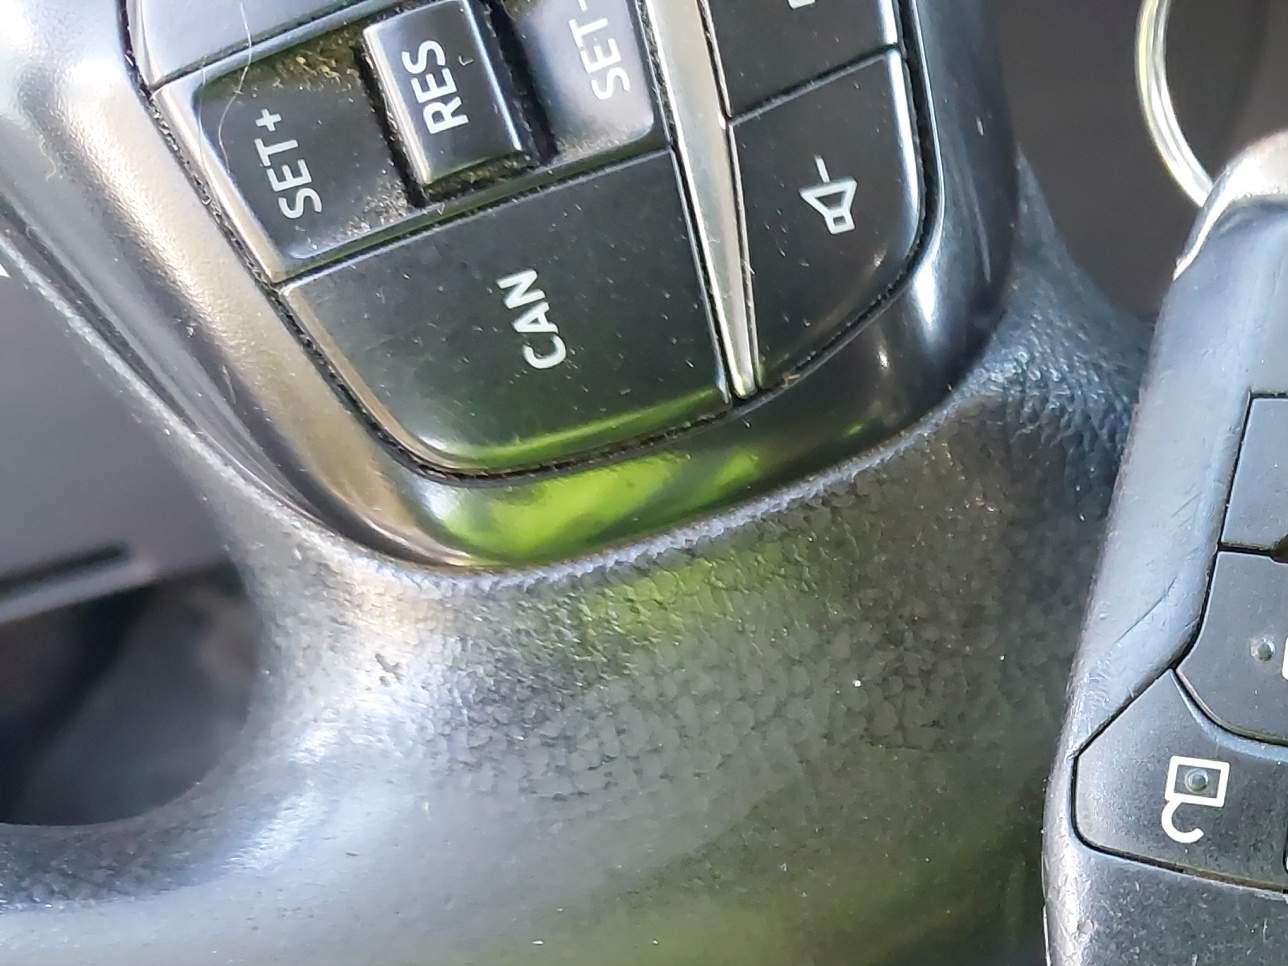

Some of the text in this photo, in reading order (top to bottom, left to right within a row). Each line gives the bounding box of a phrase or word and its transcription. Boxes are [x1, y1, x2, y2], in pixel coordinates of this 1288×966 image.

[401, 38, 470, 135] RES
[254, 107, 323, 220] SET+
[496, 268, 568, 370] CAN
